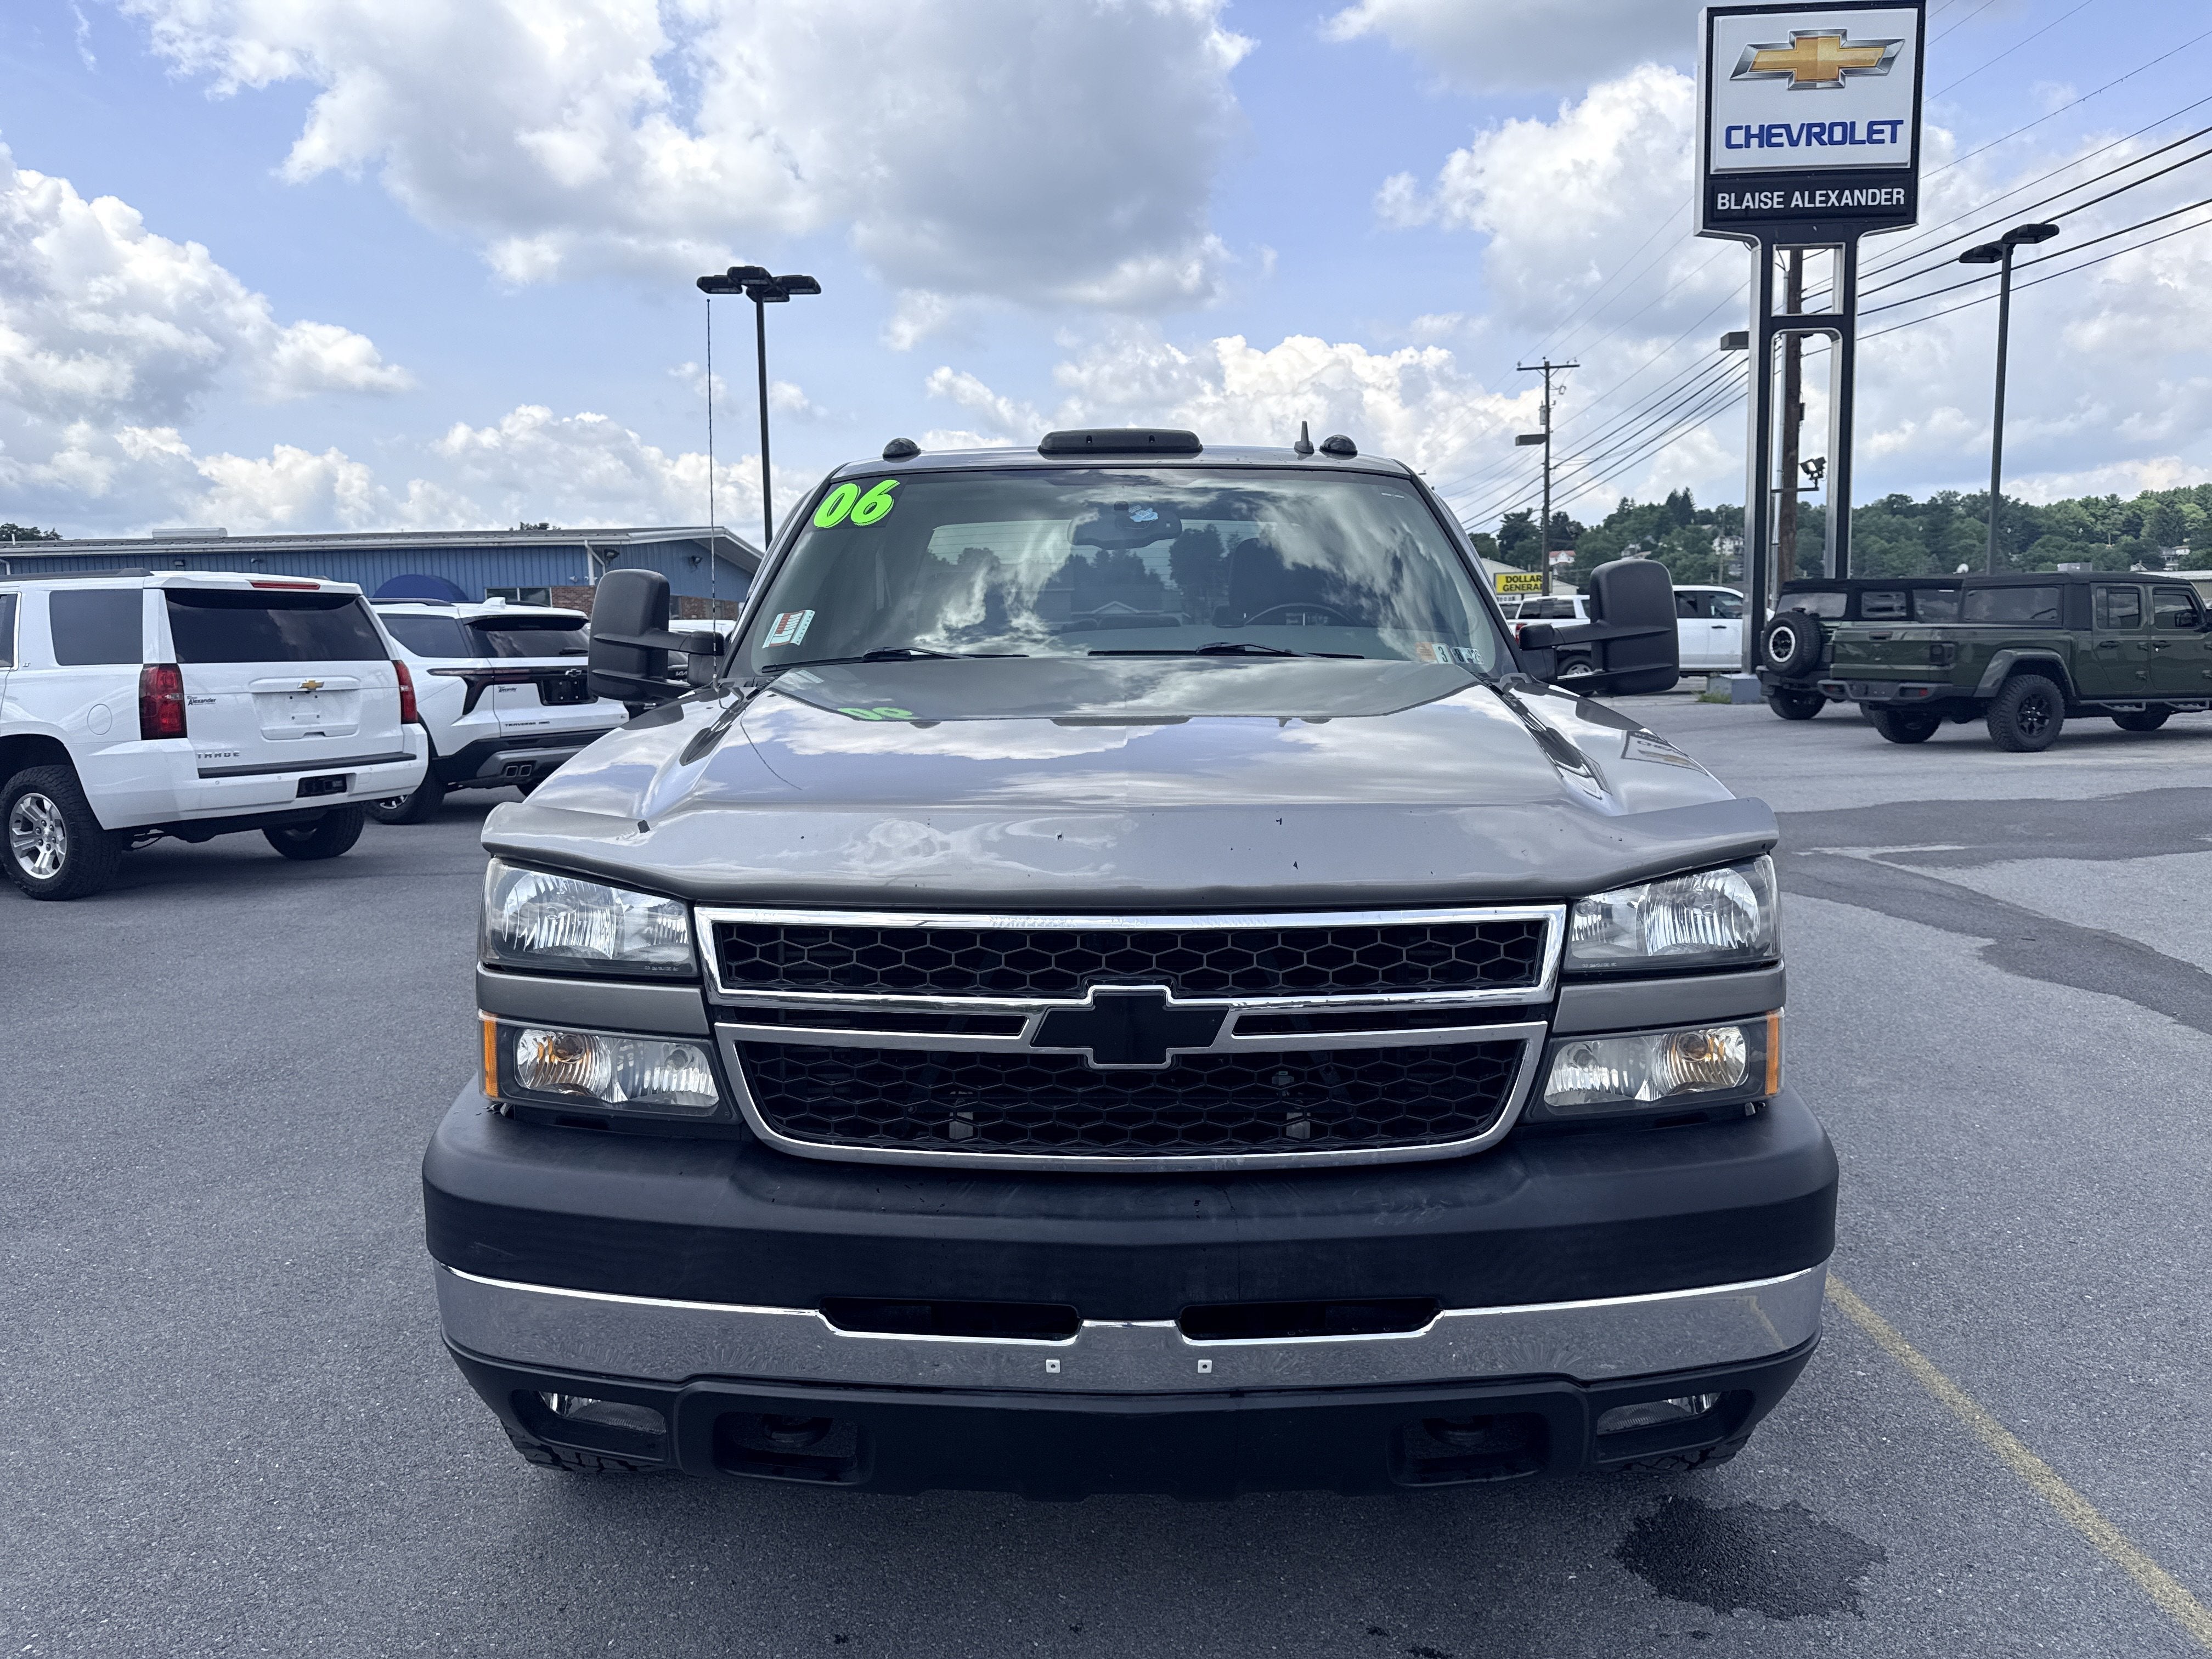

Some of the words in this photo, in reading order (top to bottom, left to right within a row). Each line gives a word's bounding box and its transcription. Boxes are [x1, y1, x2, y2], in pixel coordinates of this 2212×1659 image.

[1725, 120, 1904, 149] CHEVROLET
[1717, 191, 1785, 210] BLAISE
[1790, 188, 1905, 208] ALEXANDER
[813, 479, 901, 528] 06
[1505, 575, 1543, 583] DOLLAR
[197, 751, 240, 759] TAHOE
